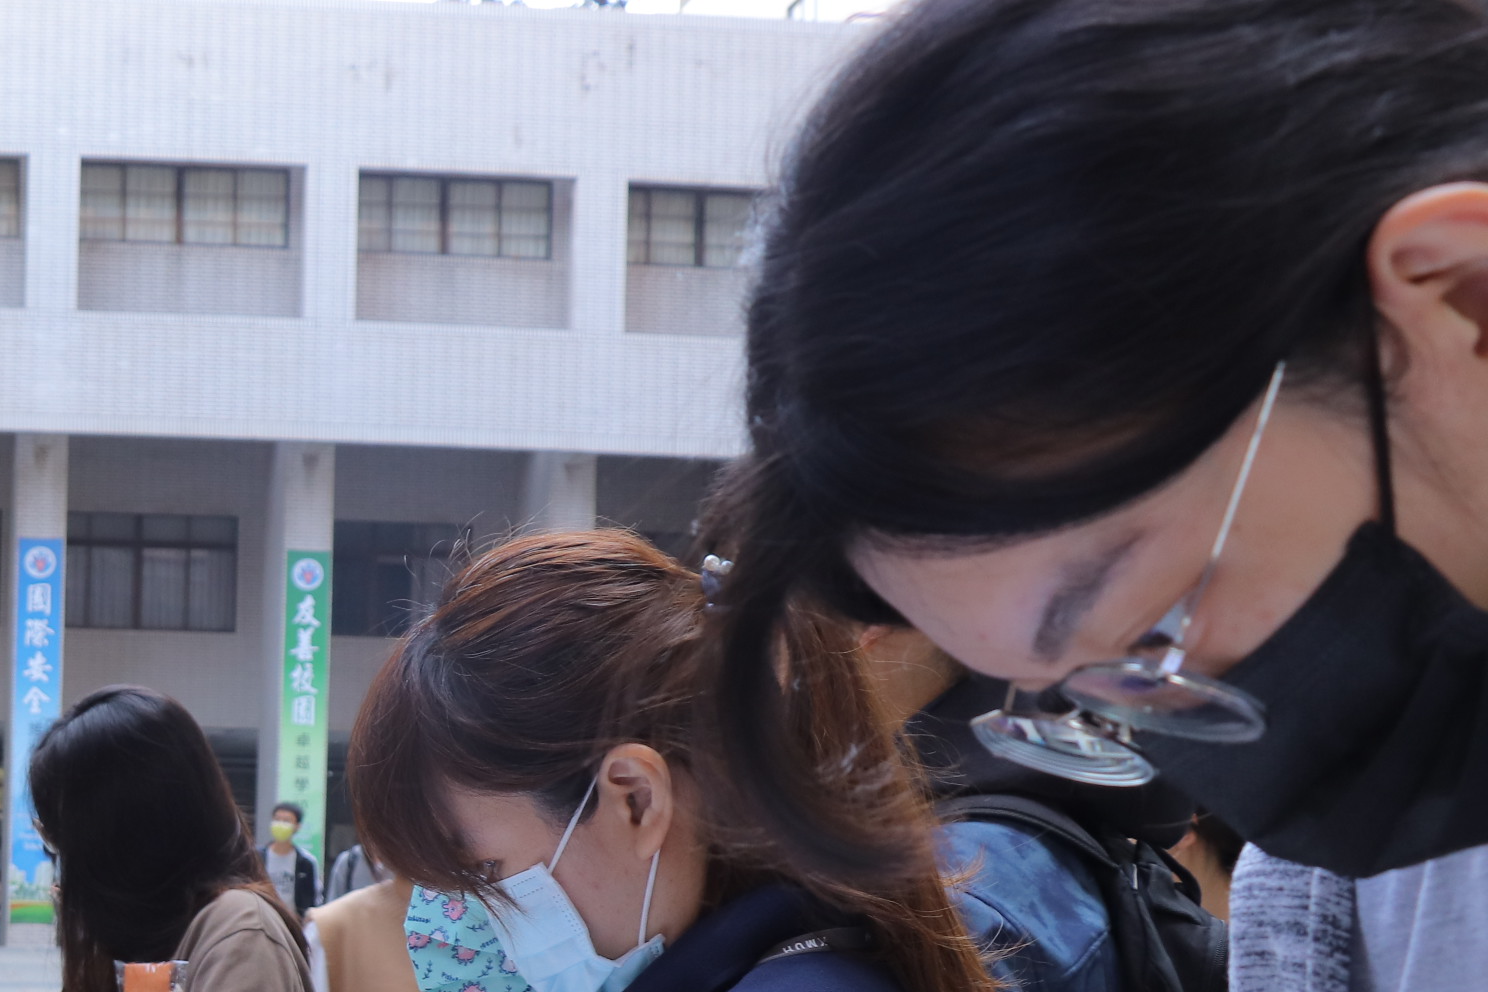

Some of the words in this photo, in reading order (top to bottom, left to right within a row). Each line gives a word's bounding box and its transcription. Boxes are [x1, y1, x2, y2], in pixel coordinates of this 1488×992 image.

[23, 582, 56, 714] 國際安全
[288, 594, 321, 727] 友善校園
